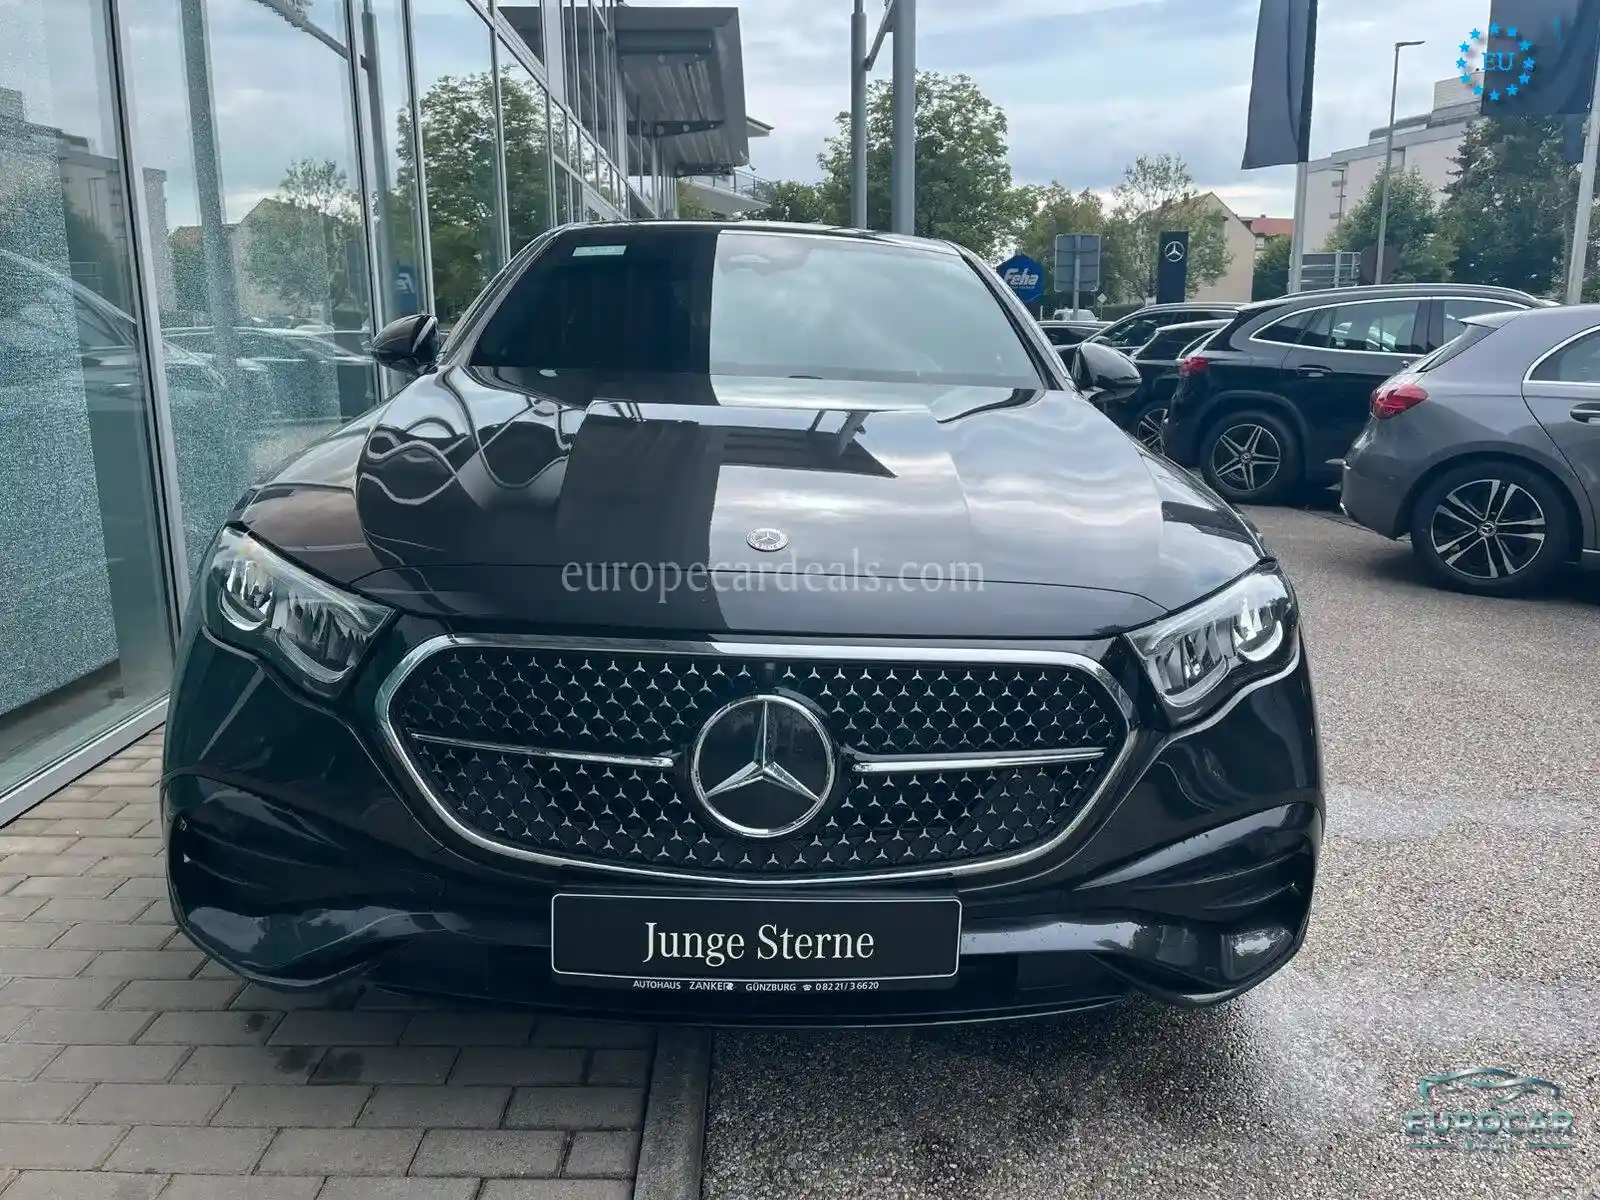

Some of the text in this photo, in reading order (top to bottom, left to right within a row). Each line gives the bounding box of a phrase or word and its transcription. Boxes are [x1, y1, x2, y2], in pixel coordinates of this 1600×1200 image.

[1003, 267, 1039, 286] Feha
[642, 921, 875, 967] Junge Sterne
[633, 980, 682, 990] AUTOHAUS
[745, 981, 797, 992] GÜNZBURG
